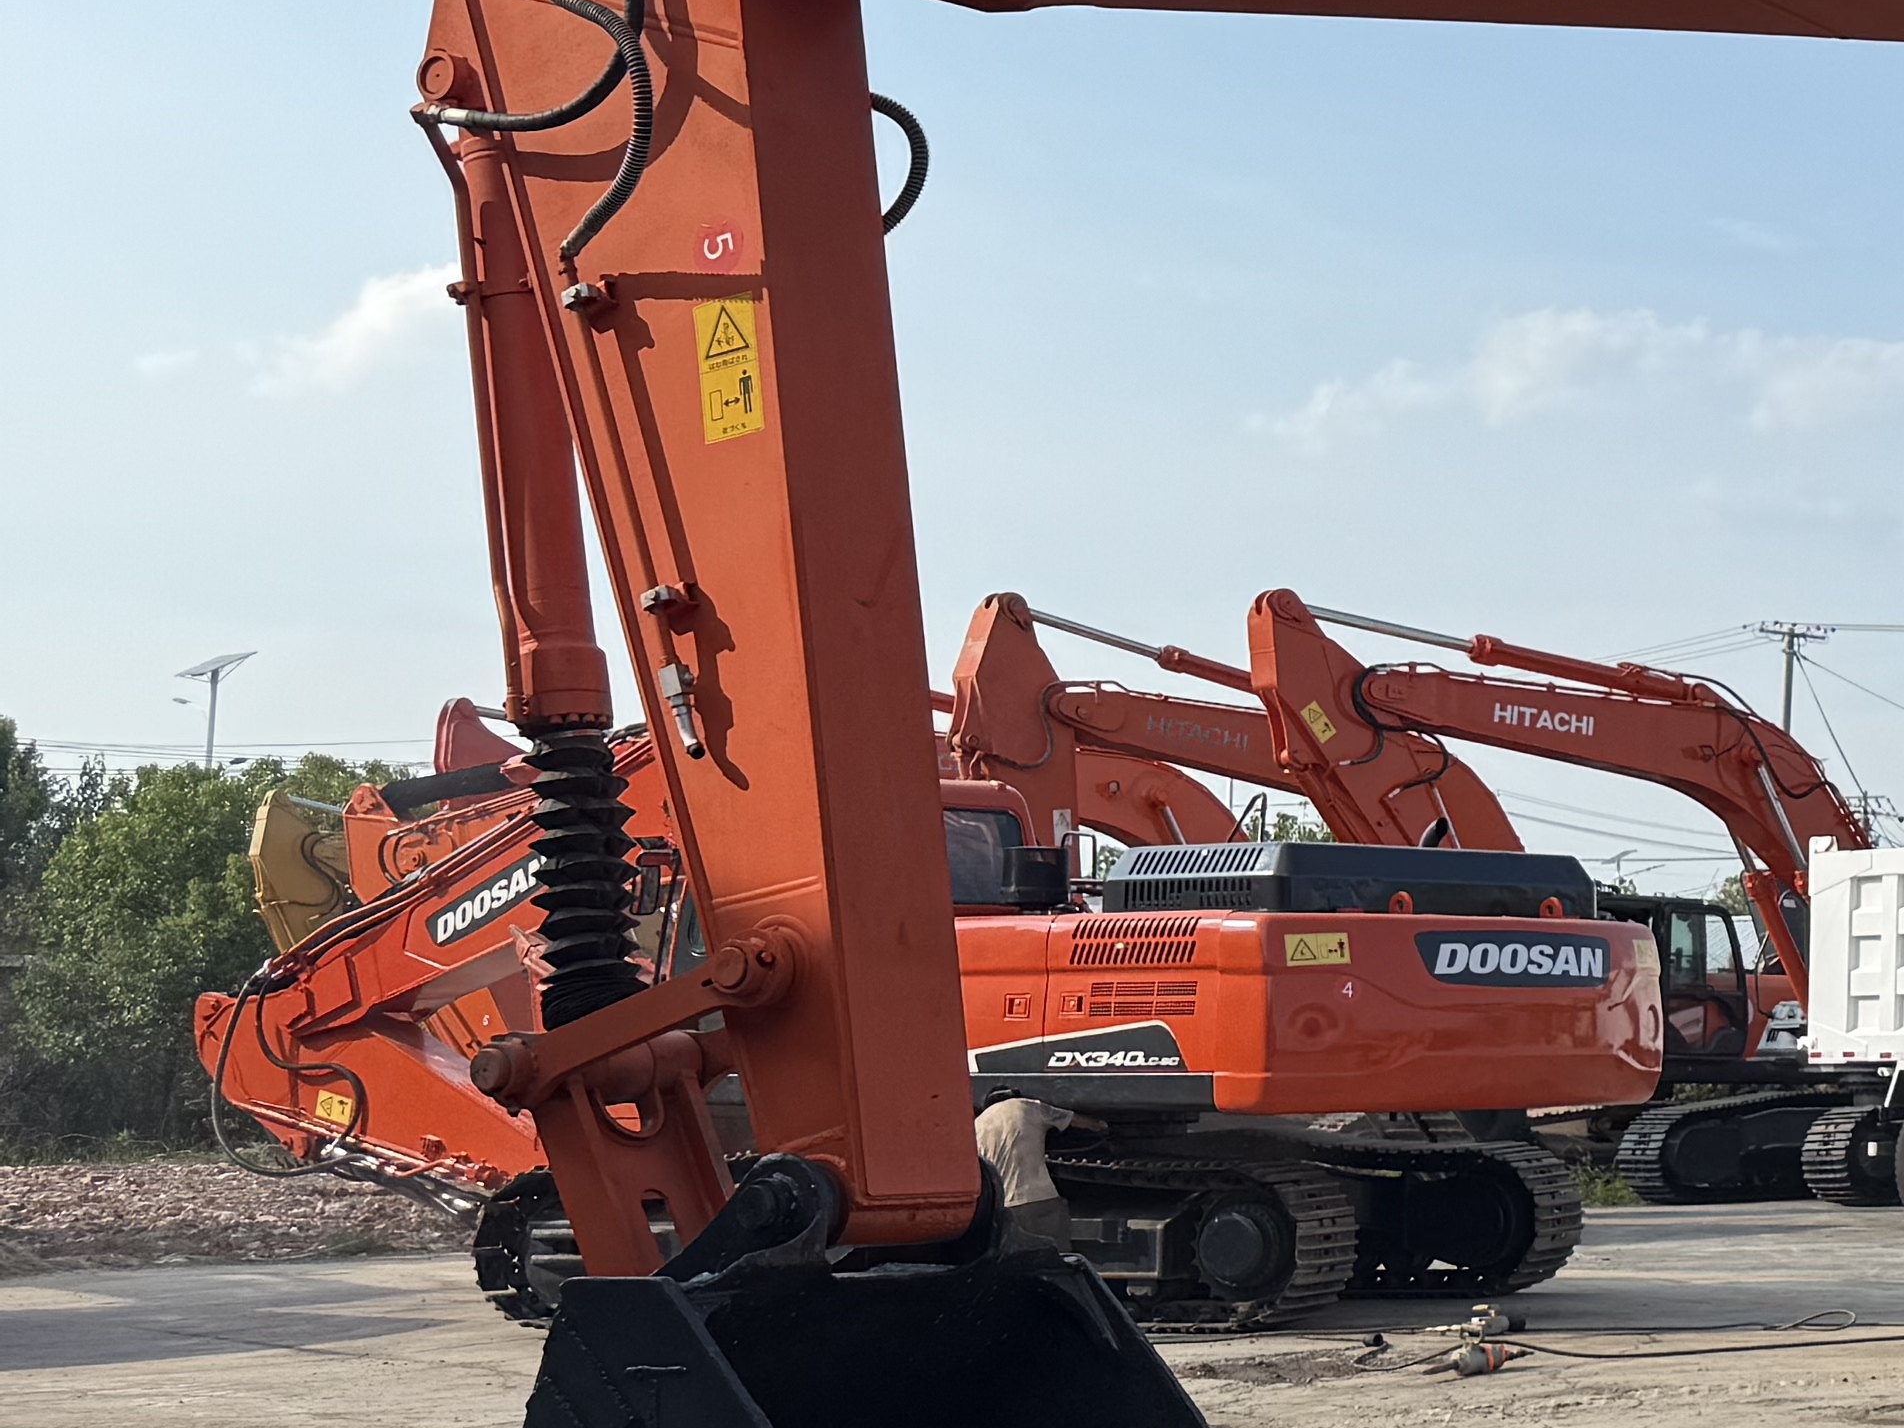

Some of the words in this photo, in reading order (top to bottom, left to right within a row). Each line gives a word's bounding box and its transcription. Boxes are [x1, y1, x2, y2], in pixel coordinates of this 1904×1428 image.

[703, 232, 734, 260] 5
[1147, 715, 1249, 752] HITACHI
[1494, 702, 1595, 737] HITACHI
[1434, 942, 1604, 978] DOOSAN
[1342, 981, 1354, 999] 4
